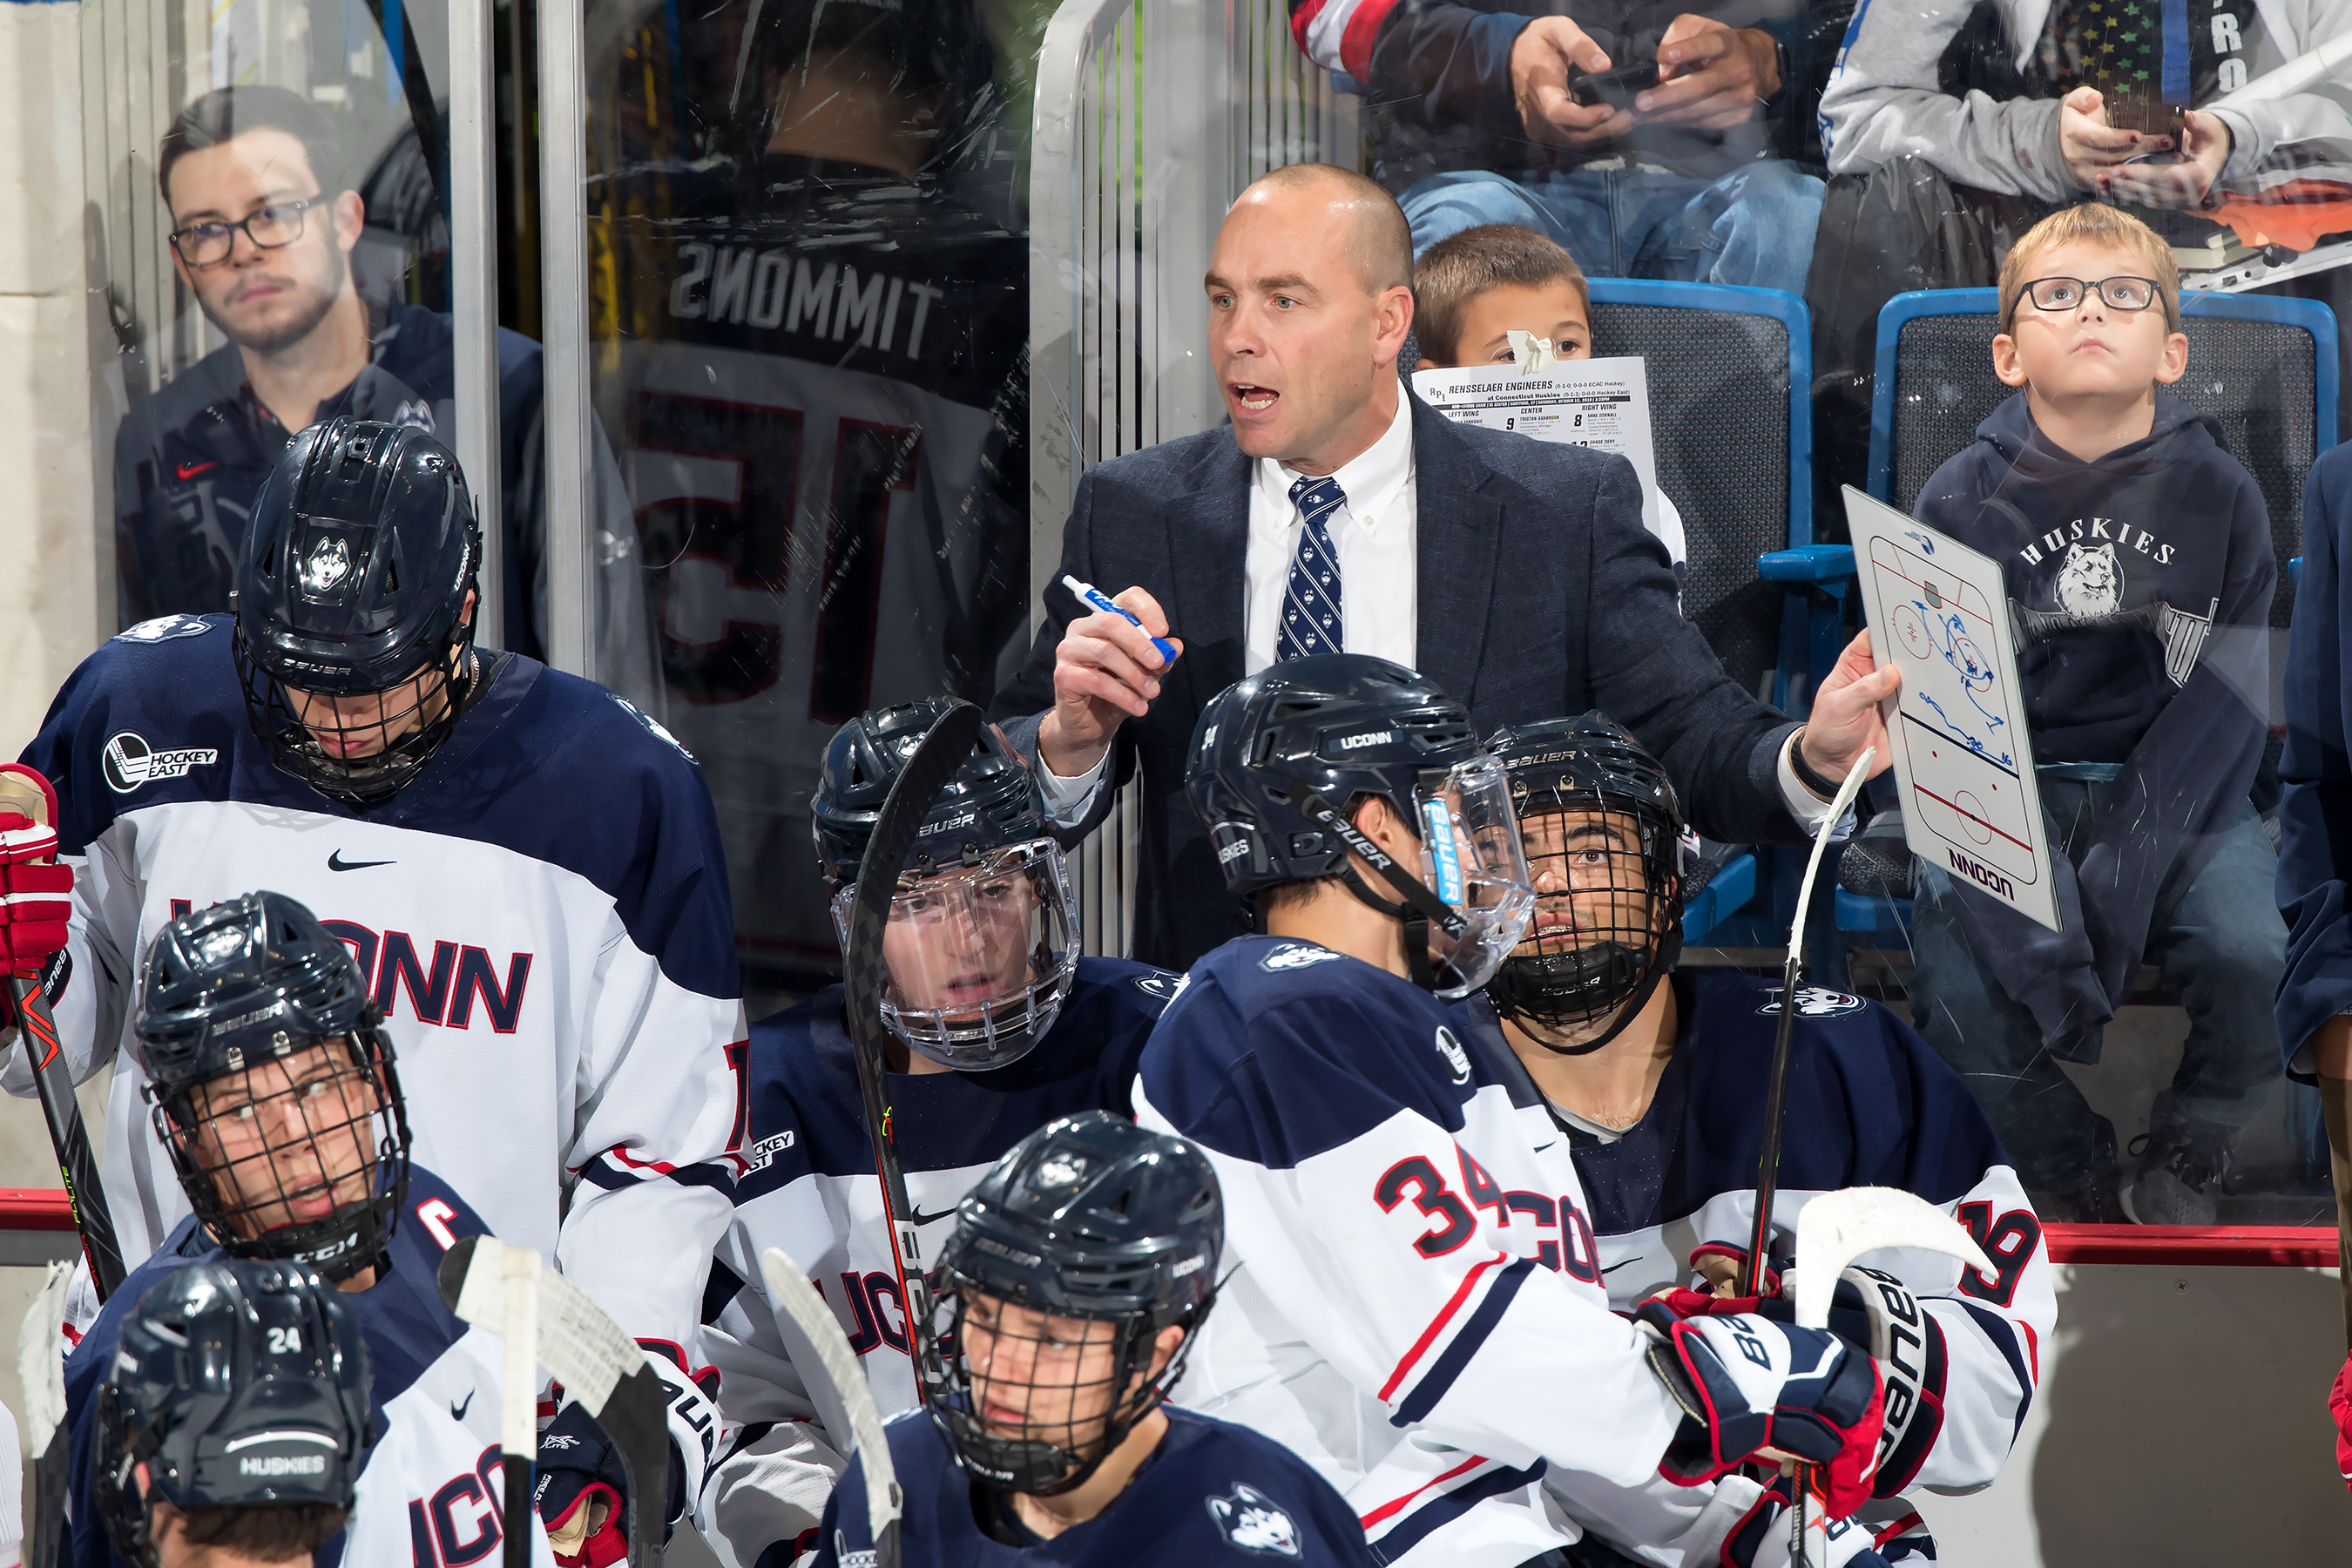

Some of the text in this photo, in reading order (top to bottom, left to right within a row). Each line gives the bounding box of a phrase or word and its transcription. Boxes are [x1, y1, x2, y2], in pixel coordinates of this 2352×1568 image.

[1449, 382, 1503, 395] RENSSELAER
[1505, 380, 1553, 391] ENGINEERS
[1506, 417, 1515, 430] 9
[1573, 414, 1583, 427] 8
[2020, 517, 2175, 566] HUSKIES
[454, 543, 470, 591] UCONN
[1201, 725, 1220, 751] 34
[1341, 731, 1392, 750] UCONN
[148, 763, 186, 778] EAST
[151, 751, 214, 767] HOCKEY
[1505, 750, 1577, 770] BAUER
[916, 814, 975, 837] AUER
[1429, 801, 1461, 902] BAUER
[1947, 848, 2016, 902] UCONN
[44, 949, 67, 997] BAUE
[1374, 1155, 1511, 1260] 34
[1957, 1199, 2042, 1309] 19
[267, 1327, 302, 1354] 24
[240, 1454, 327, 1477] HUSKIES
[1792, 1504, 1801, 1552] BAUER
